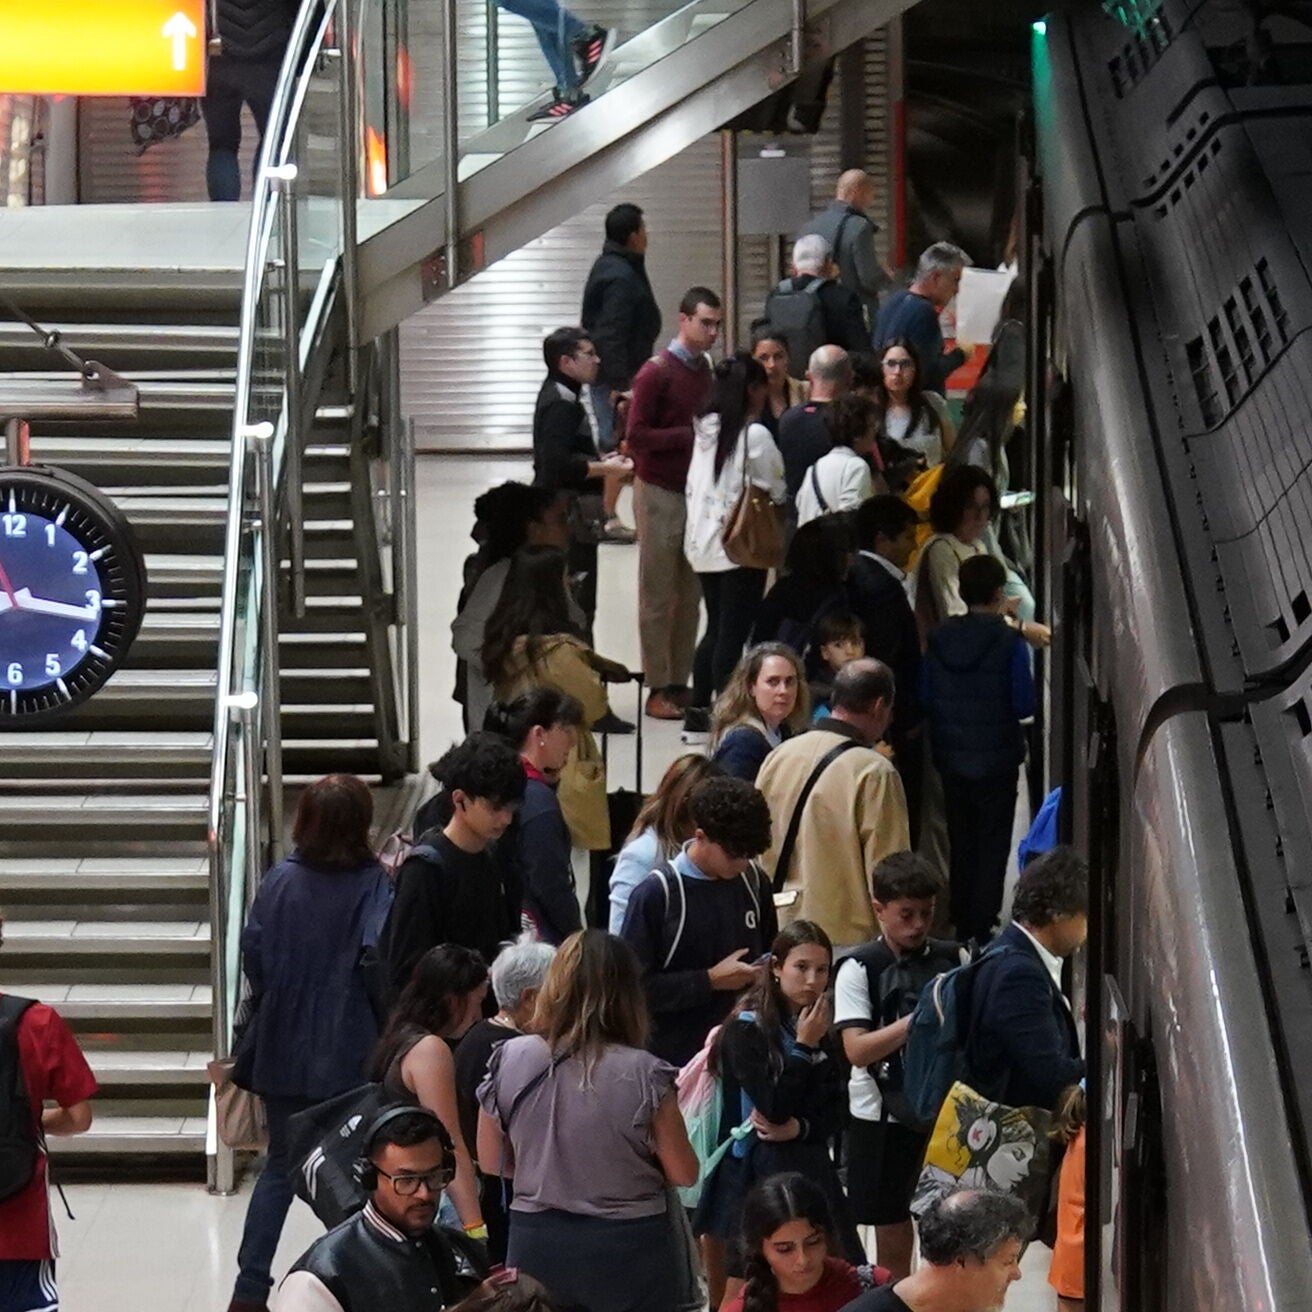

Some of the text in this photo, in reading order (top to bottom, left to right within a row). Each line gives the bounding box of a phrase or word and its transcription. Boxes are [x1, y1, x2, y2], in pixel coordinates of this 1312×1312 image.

[1, 514, 27, 537] 12
[44, 524, 55, 546] 1
[72, 551, 88, 573] 2
[85, 590, 101, 611] 3
[71, 629, 88, 651] 4
[7, 663, 23, 684] 6
[45, 653, 61, 676] 5
